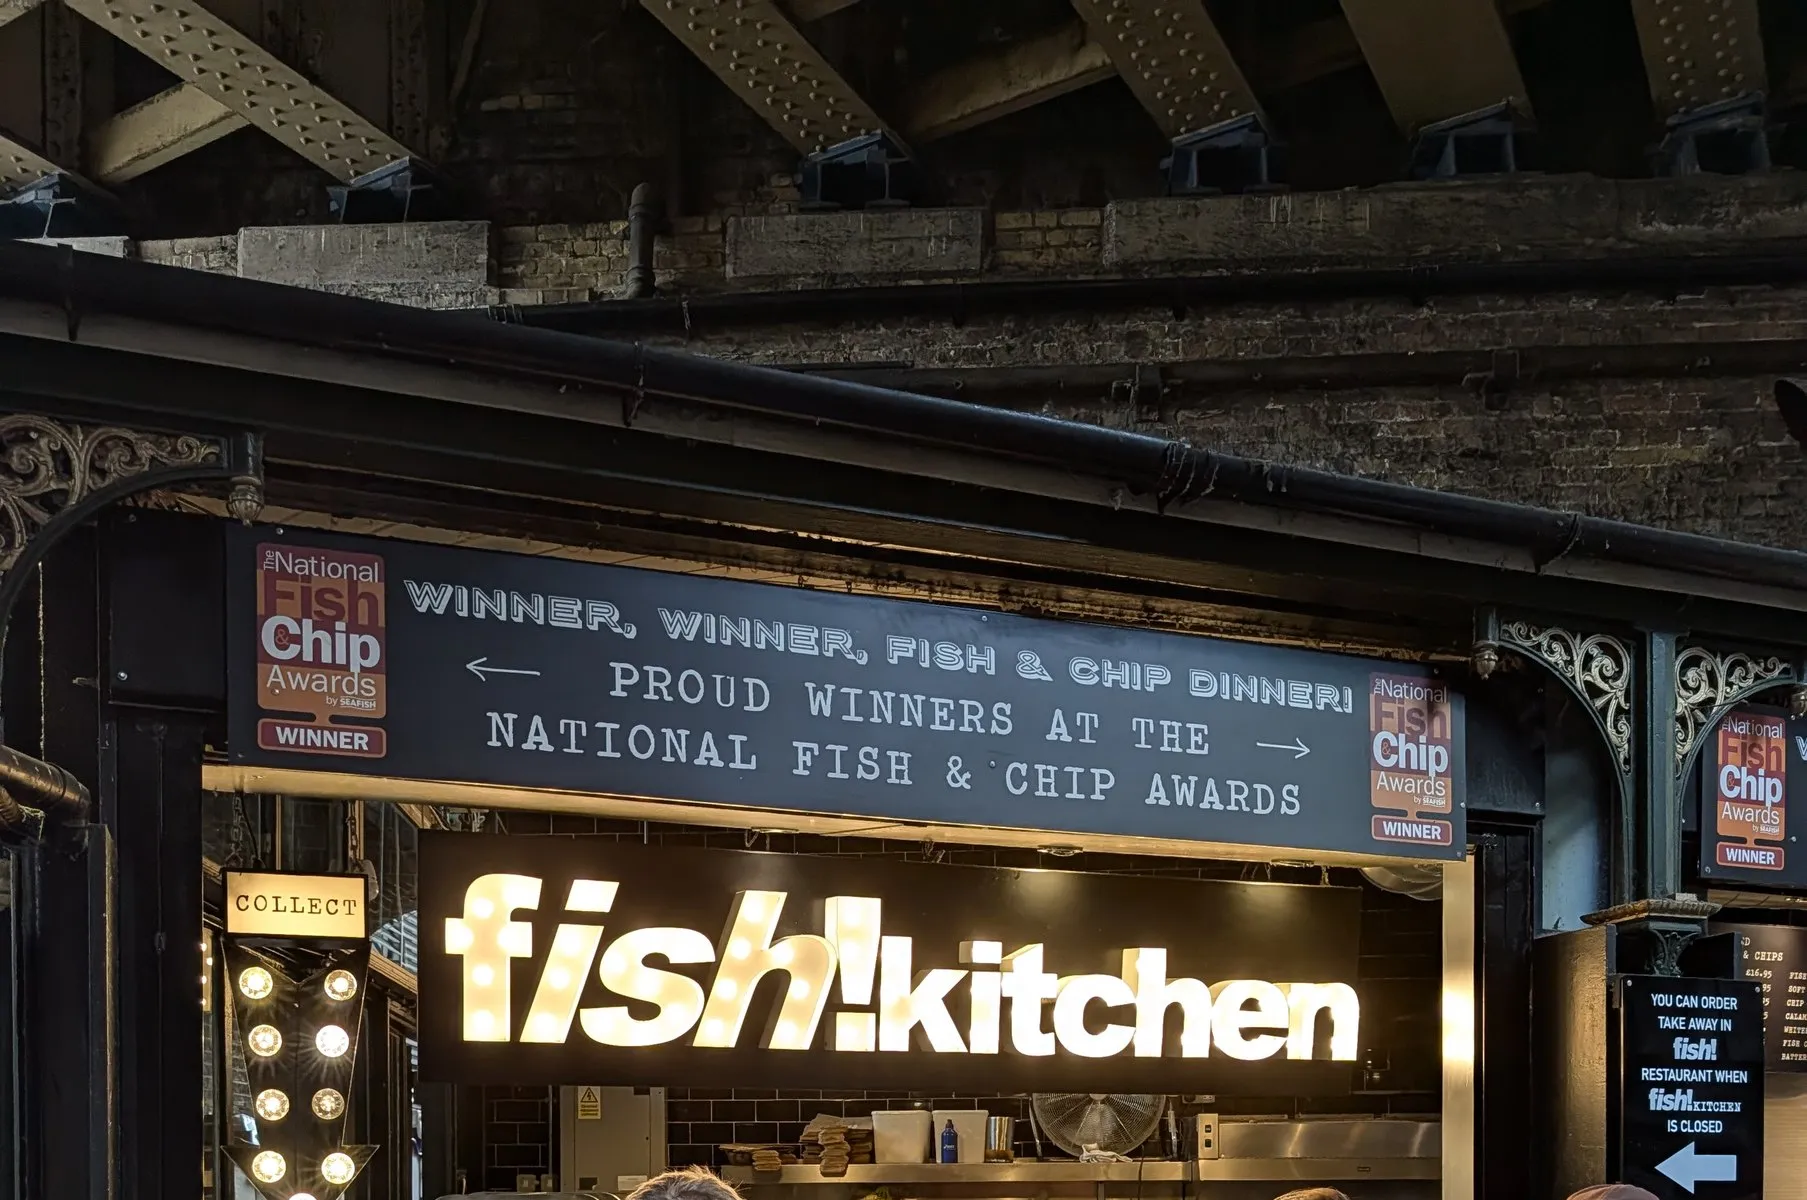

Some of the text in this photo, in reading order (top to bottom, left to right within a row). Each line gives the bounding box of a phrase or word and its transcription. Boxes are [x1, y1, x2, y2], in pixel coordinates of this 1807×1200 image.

[264, 550, 378, 582] The National
[264, 572, 379, 627] Fish
[261, 616, 380, 674] Chip
[403, 579, 1352, 714] WINNER, WINNER, FISH & CHIP DINNER!
[266, 664, 376, 697] Awards
[1382, 678, 1447, 704] National
[326, 696, 376, 709] by SEAFISH
[609, 662, 1210, 755] PROUD WINNERS AT THE
[1375, 696, 1448, 738] Fish
[1728, 716, 1782, 738] National
[275, 726, 369, 750] WINNER
[486, 712, 1302, 816] NATIONAL FISH & CHIP AWARDS
[1372, 730, 1448, 778] Chip
[1722, 733, 1782, 772] Fish
[1376, 771, 1446, 796] Awards
[1720, 764, 1783, 807] Chip
[1721, 802, 1780, 825] Awards
[1382, 820, 1442, 840] WINNER
[1726, 848, 1776, 865] WINNER
[235, 894, 358, 917] COLLECT
[1754, 951, 1784, 962] CHIPS
[1746, 968, 1772, 980] £16.95
[1651, 993, 1738, 1010] YOU CAN ORDER
[1786, 999, 1804, 1007] CHIP
[1658, 1016, 1732, 1032] TAKE AWAY IN
[1673, 1036, 1718, 1060] fish!
[1642, 1068, 1748, 1084] RESTAURANT WHEN
[1668, 1120, 1722, 1133] IS CLOSED
